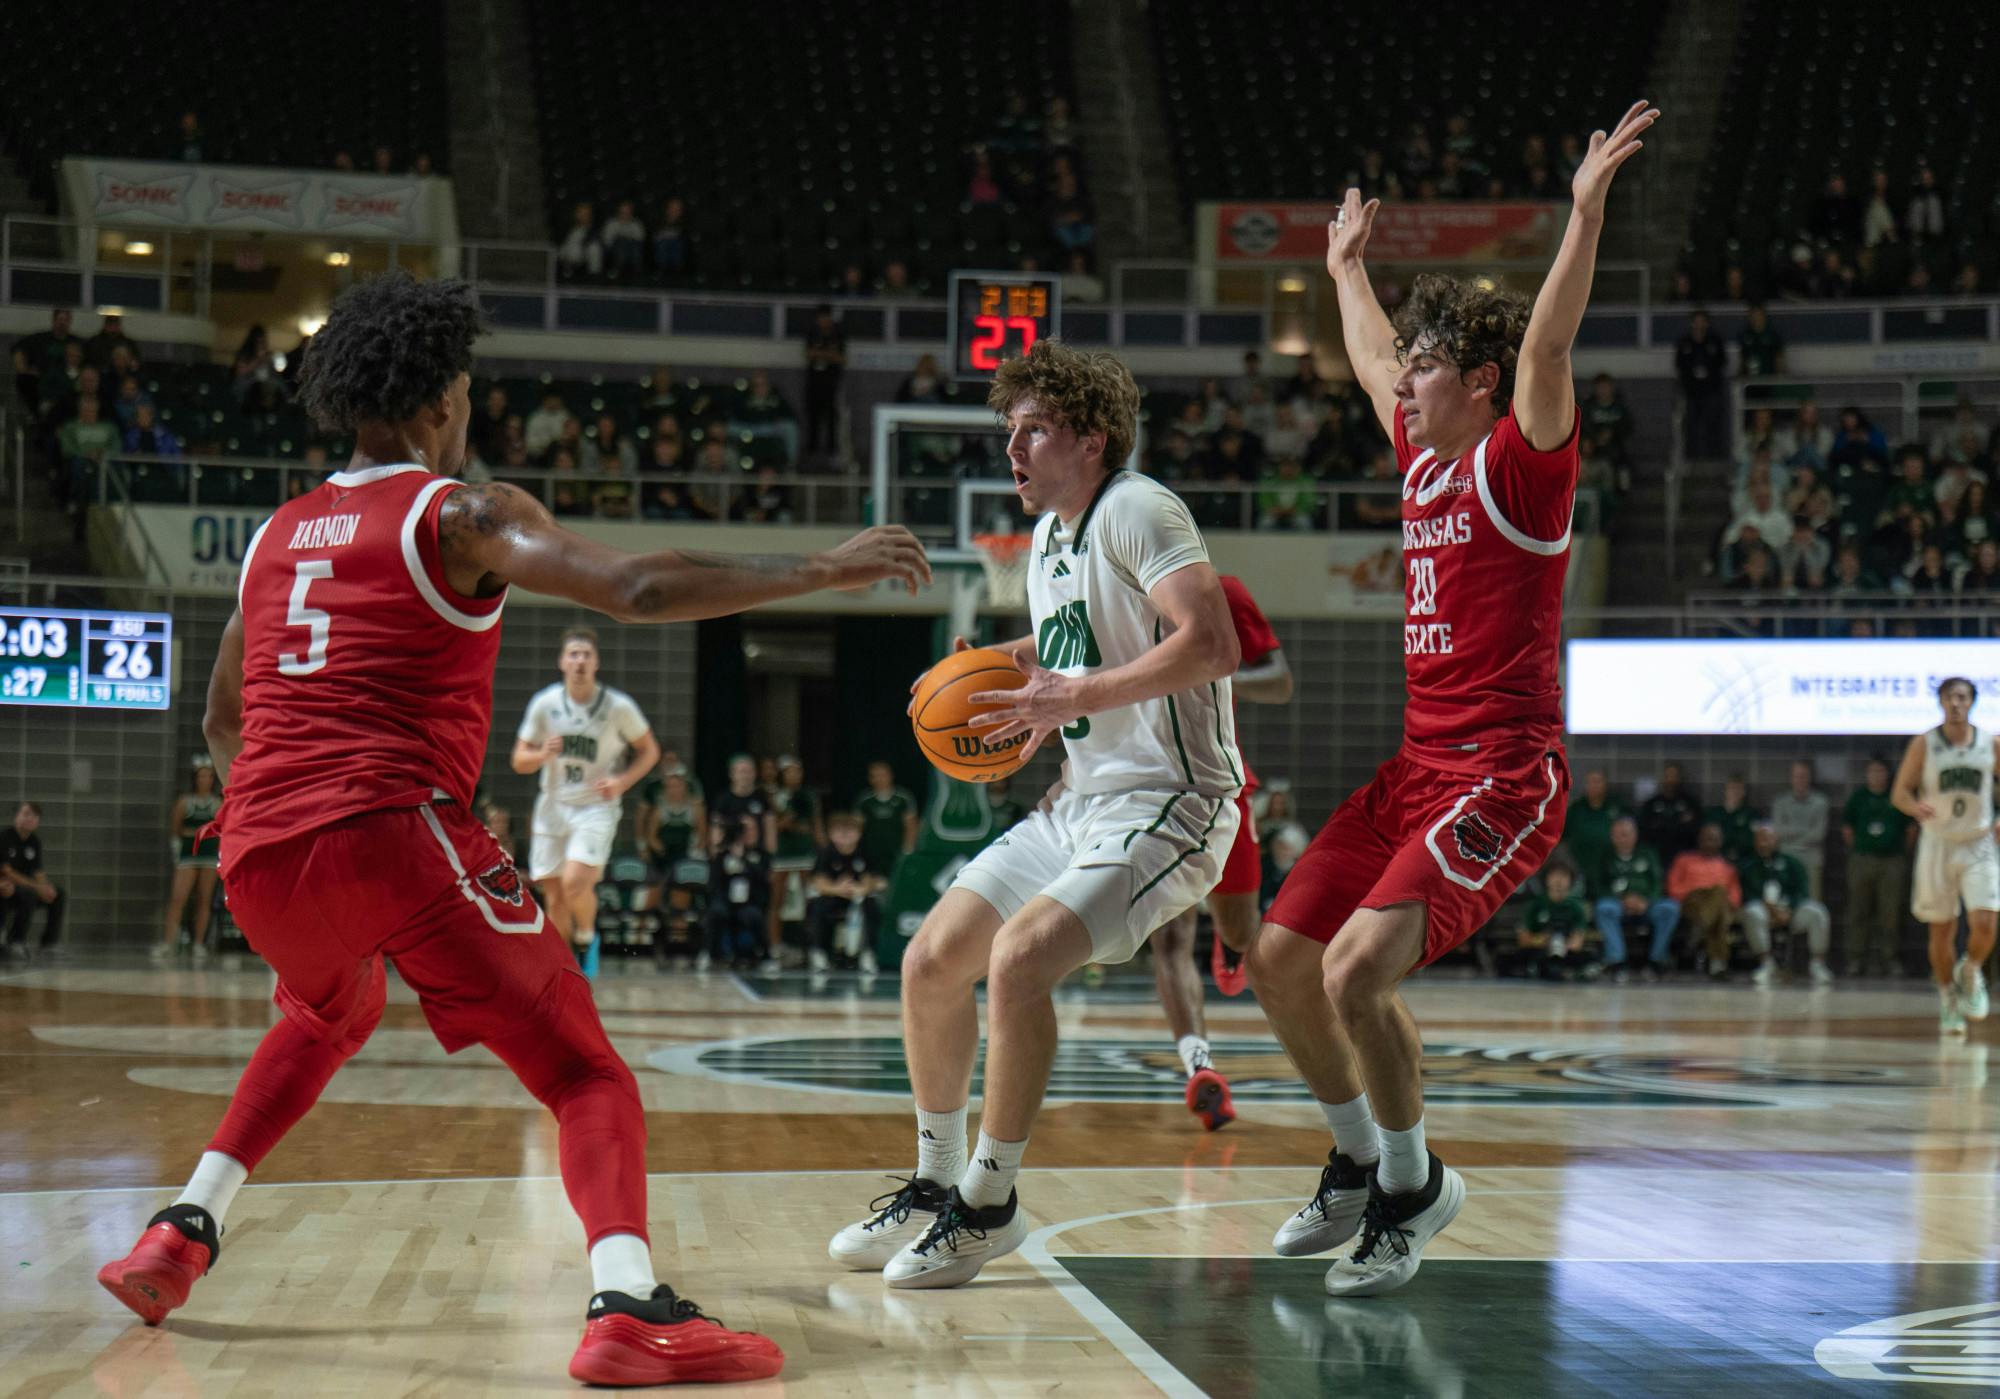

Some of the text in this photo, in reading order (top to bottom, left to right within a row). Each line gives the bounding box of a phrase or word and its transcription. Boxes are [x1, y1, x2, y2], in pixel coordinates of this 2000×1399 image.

[111, 183, 177, 203] SONIC
[223, 190, 289, 209] SONIC
[335, 196, 401, 215] SONIC
[970, 315, 1036, 370] 27
[288, 514, 361, 550] HARMON
[277, 559, 334, 676] 5
[1404, 623, 1453, 654] STATE
[103, 640, 153, 680] 26
[1952, 799, 1967, 818] 0
